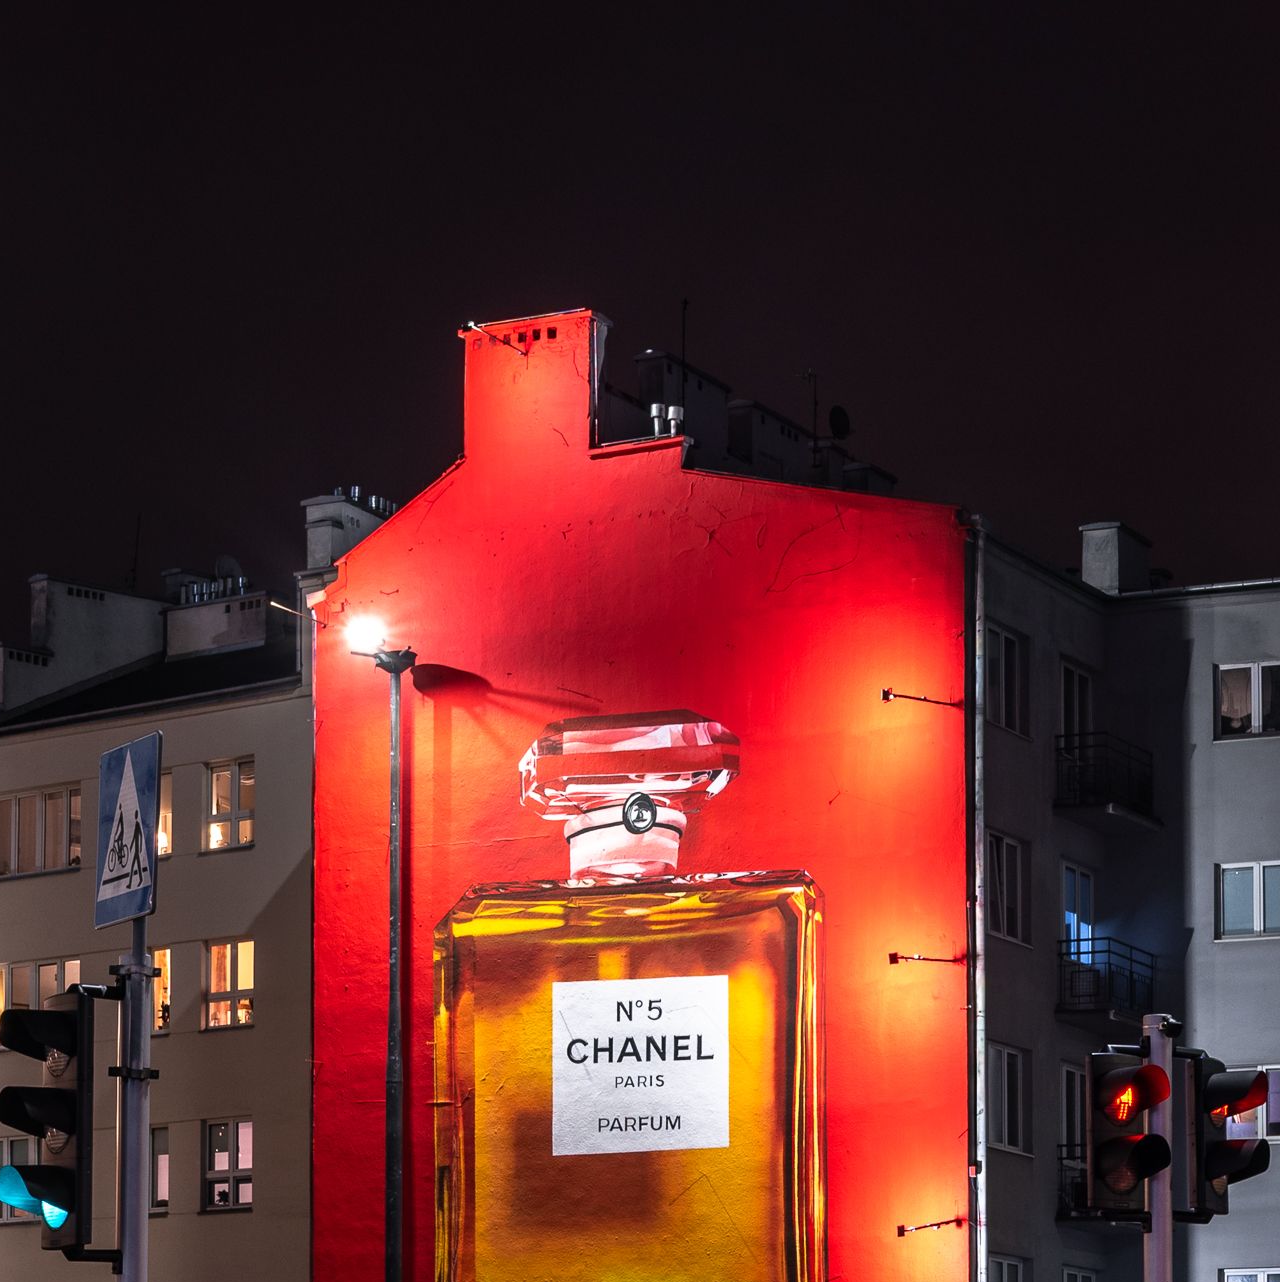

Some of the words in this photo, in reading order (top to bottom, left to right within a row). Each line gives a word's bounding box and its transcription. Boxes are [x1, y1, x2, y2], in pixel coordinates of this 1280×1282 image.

[566, 1034, 714, 1064] CHANEL
[614, 1074, 665, 1089] PARIS
[597, 1115, 682, 1133] PARFUM
